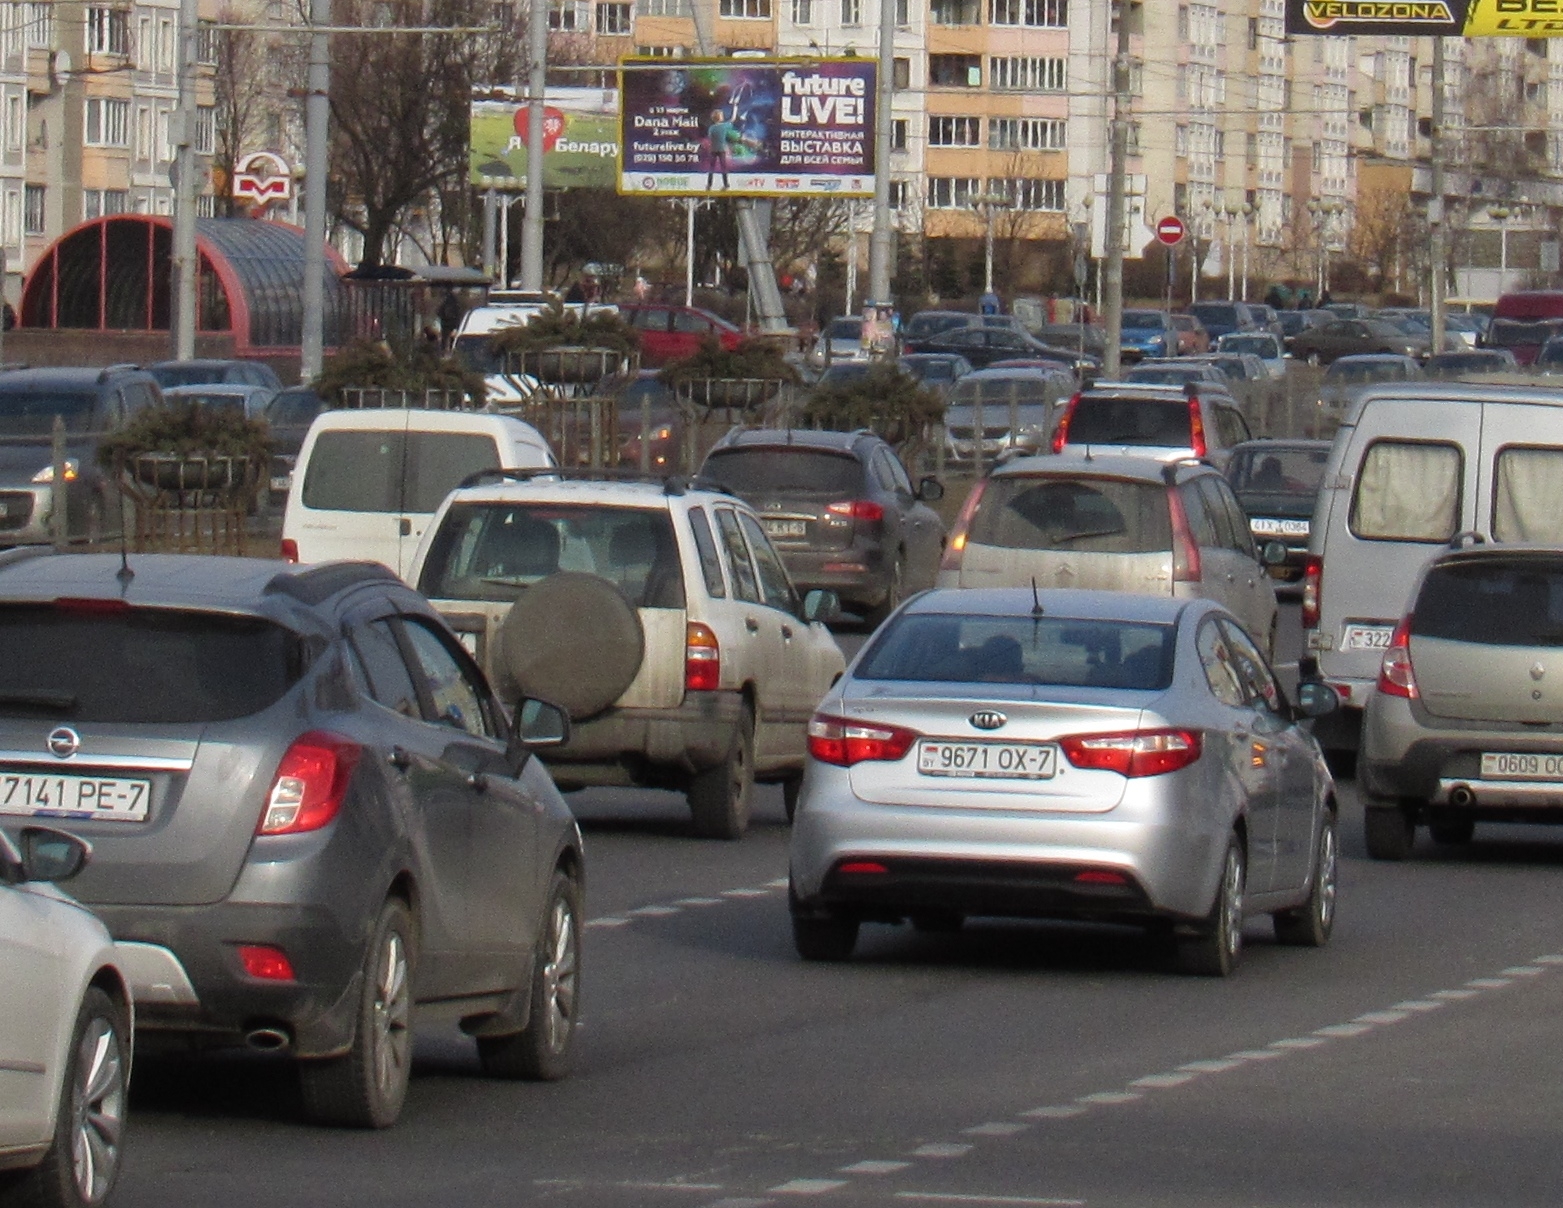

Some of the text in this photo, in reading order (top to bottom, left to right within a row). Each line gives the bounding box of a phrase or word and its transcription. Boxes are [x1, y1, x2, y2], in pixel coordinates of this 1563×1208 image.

[1308, 2, 1449, 19] VELOZONA
[781, 71, 866, 96] future
[781, 96, 865, 124] LIVE!
[634, 116, 669, 128] Dana
[780, 129, 865, 140] ИНТЕРАКТИВНАЯ
[554, 138, 619, 158] Белару
[633, 141, 700, 153] futurelive.by
[780, 140, 864, 154] ВЫСТАВКА
[780, 155, 802, 165] ДЛЯ
[803, 155, 830, 164] ВСЕЙ
[1364, 631, 1391, 648] 322
[973, 712, 1000, 728] KIA
[940, 746, 1051, 772] 9671 OX-7
[1497, 755, 1539, 774] 0609
[3, 776, 145, 811] 7141 PE-7
